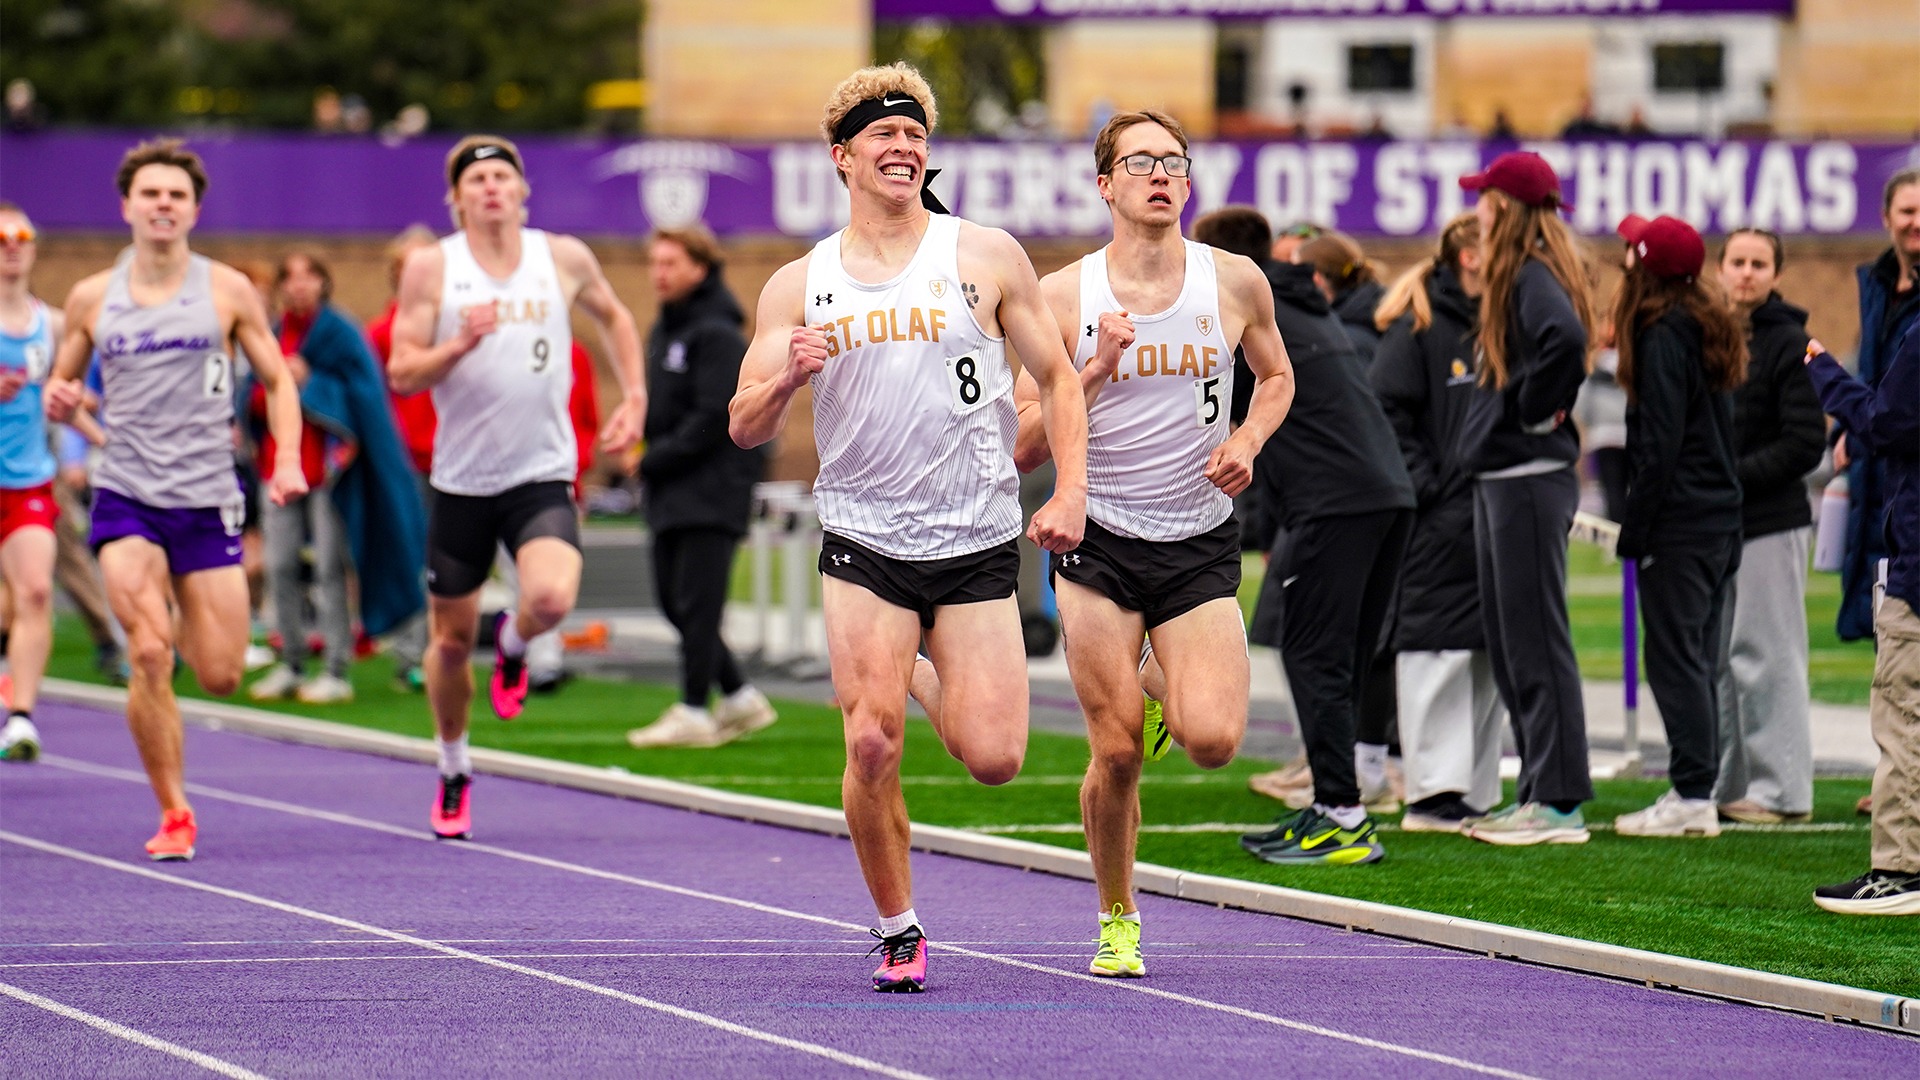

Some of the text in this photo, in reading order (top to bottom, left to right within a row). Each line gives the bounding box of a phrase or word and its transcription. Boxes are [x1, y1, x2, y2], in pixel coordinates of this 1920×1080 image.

[1255, 142, 1357, 234] OF
[131, 328, 211, 354] Thomas
[825, 307, 946, 358] ST. OLAF
[212, 356, 226, 394] 2
[532, 337, 550, 374] 9
[1137, 343, 1218, 378] OLAF
[955, 356, 981, 405] 8
[1203, 377, 1221, 426] 5
